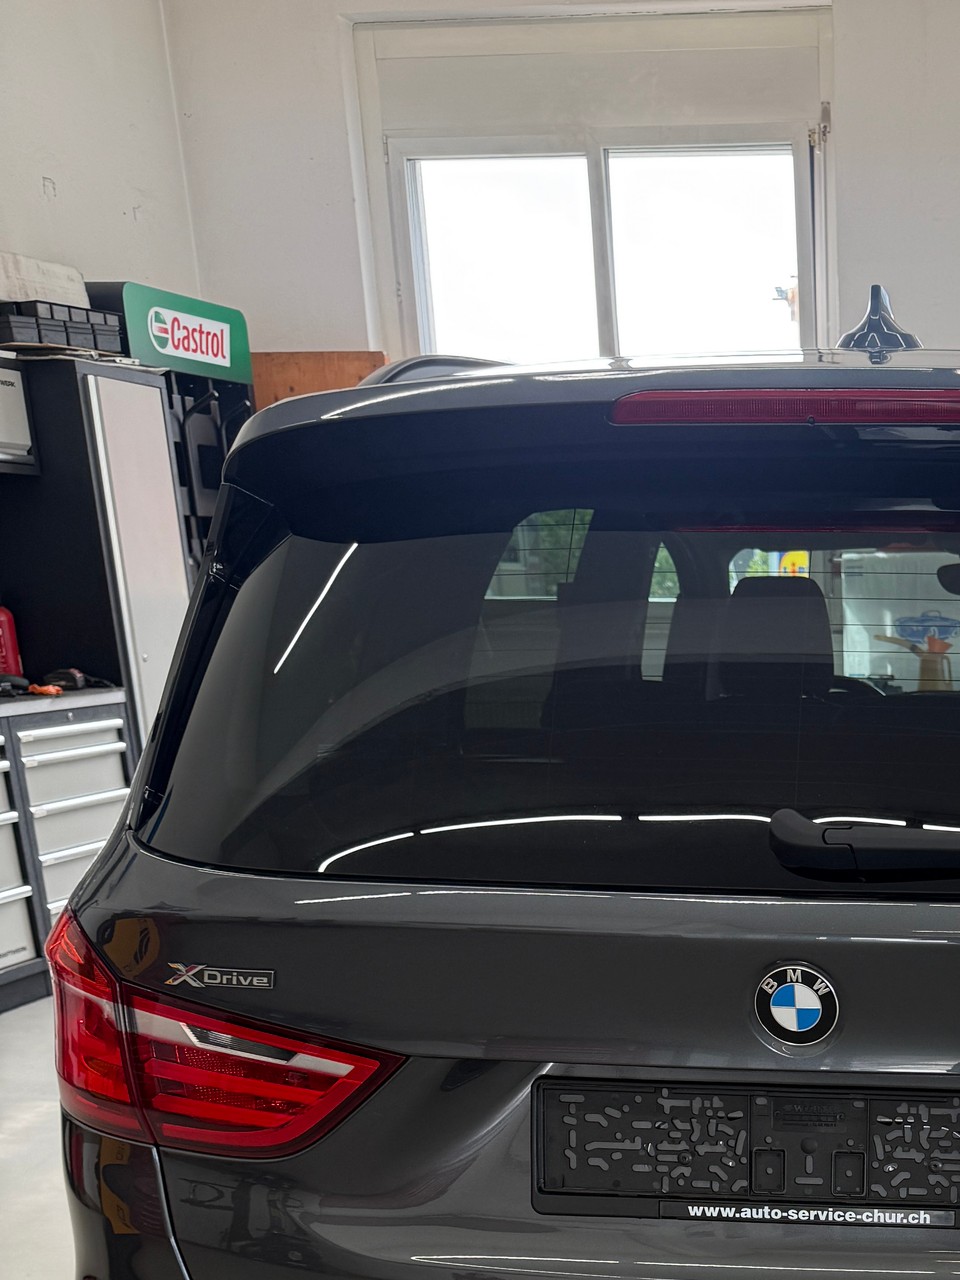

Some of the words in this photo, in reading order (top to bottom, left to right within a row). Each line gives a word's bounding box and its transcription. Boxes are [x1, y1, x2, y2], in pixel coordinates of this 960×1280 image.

[170, 316, 226, 359] Castrol
[760, 968, 831, 996] BMW
[687, 1204, 931, 1225] www.auto-service-chur.ch
